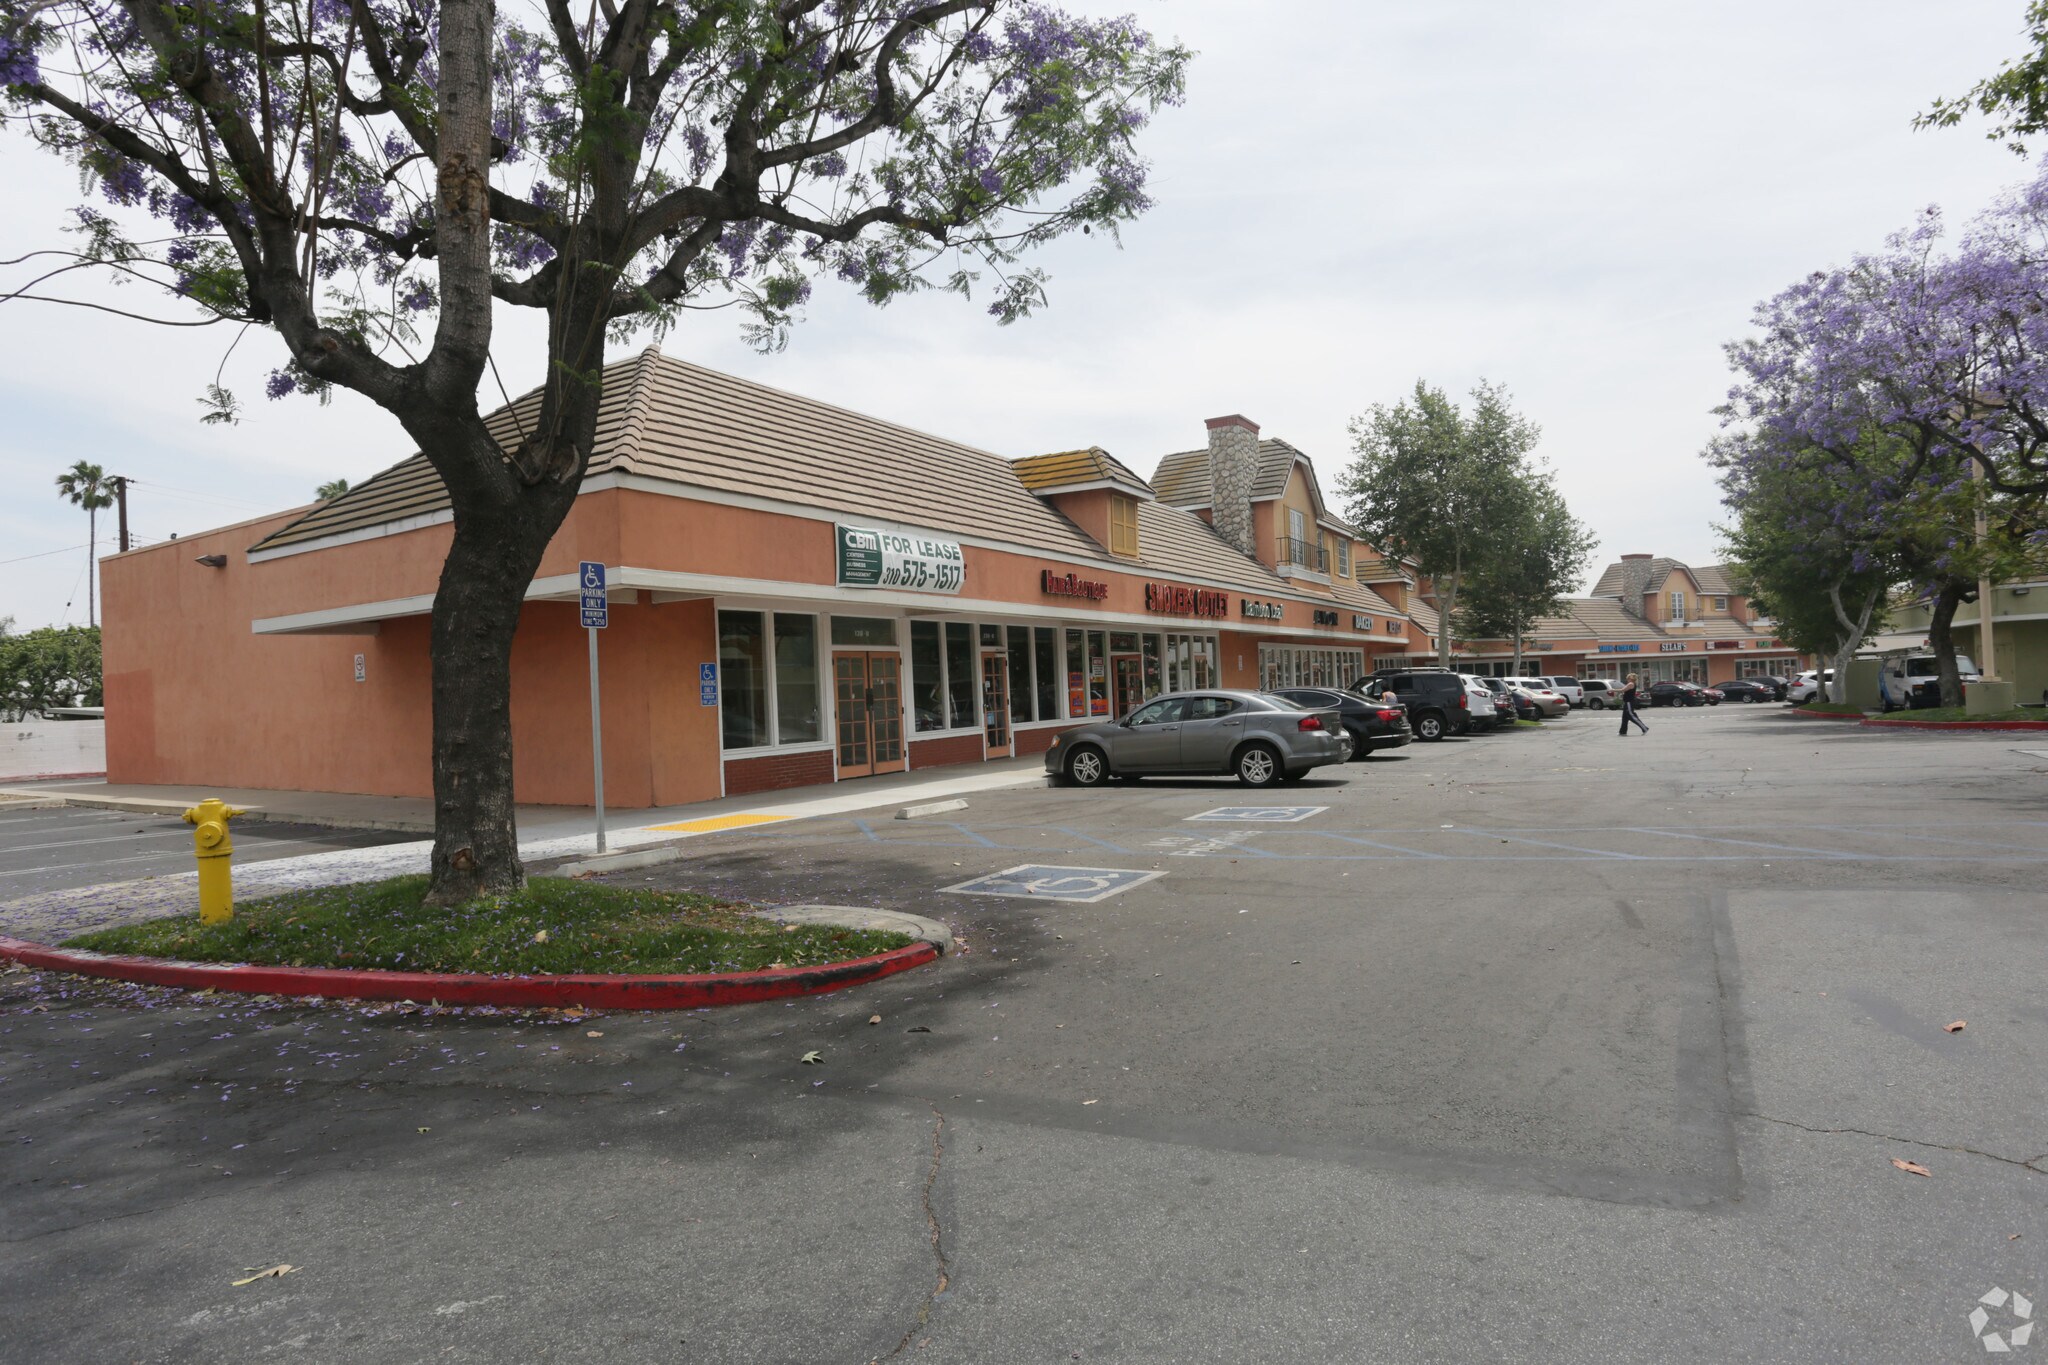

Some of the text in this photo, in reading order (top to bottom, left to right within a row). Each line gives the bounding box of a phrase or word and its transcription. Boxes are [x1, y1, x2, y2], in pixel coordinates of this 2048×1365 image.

[882, 535, 960, 560] FOR LEASE
[882, 567, 900, 585] 310
[900, 559, 960, 590] 575-1517
[582, 587, 605, 598] PARKING
[585, 598, 601, 608] ONLY
[1145, 582, 1229, 617] SMOKERS OUTLET
